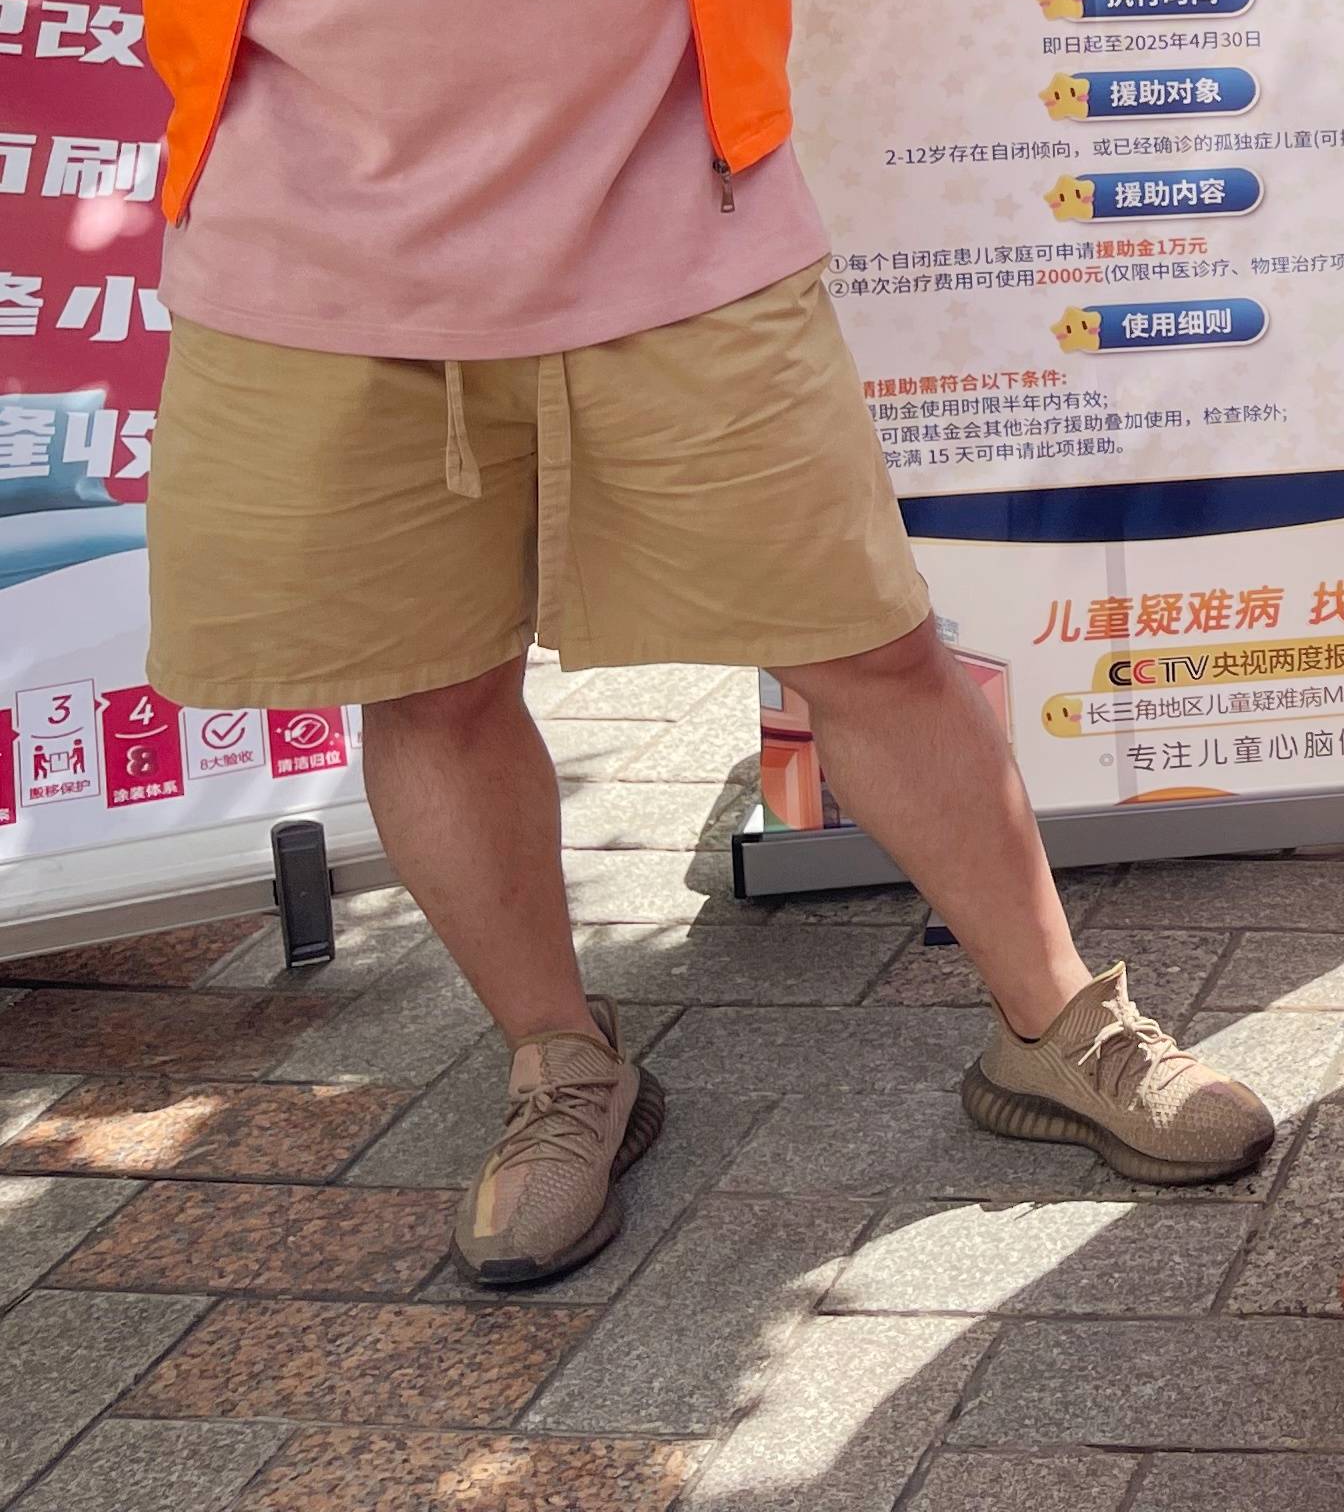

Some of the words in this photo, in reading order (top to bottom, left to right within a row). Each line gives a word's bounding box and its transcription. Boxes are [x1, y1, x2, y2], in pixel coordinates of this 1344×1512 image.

[1042, 29, 1263, 56] 即日起至2025年4月30日
[1109, 77, 1222, 107] 援助对象
[1114, 179, 1226, 209] 援助内容
[1121, 309, 1232, 338] 使用细则
[928, 449, 950, 464] 15
[1033, 587, 1283, 646] 儿童疑难病
[48, 695, 72, 724] 3
[130, 696, 154, 725] 4
[200, 750, 254, 771] 8大验收
[277, 751, 342, 774] 清洁归位
[114, 783, 178, 804] 涂装体系
